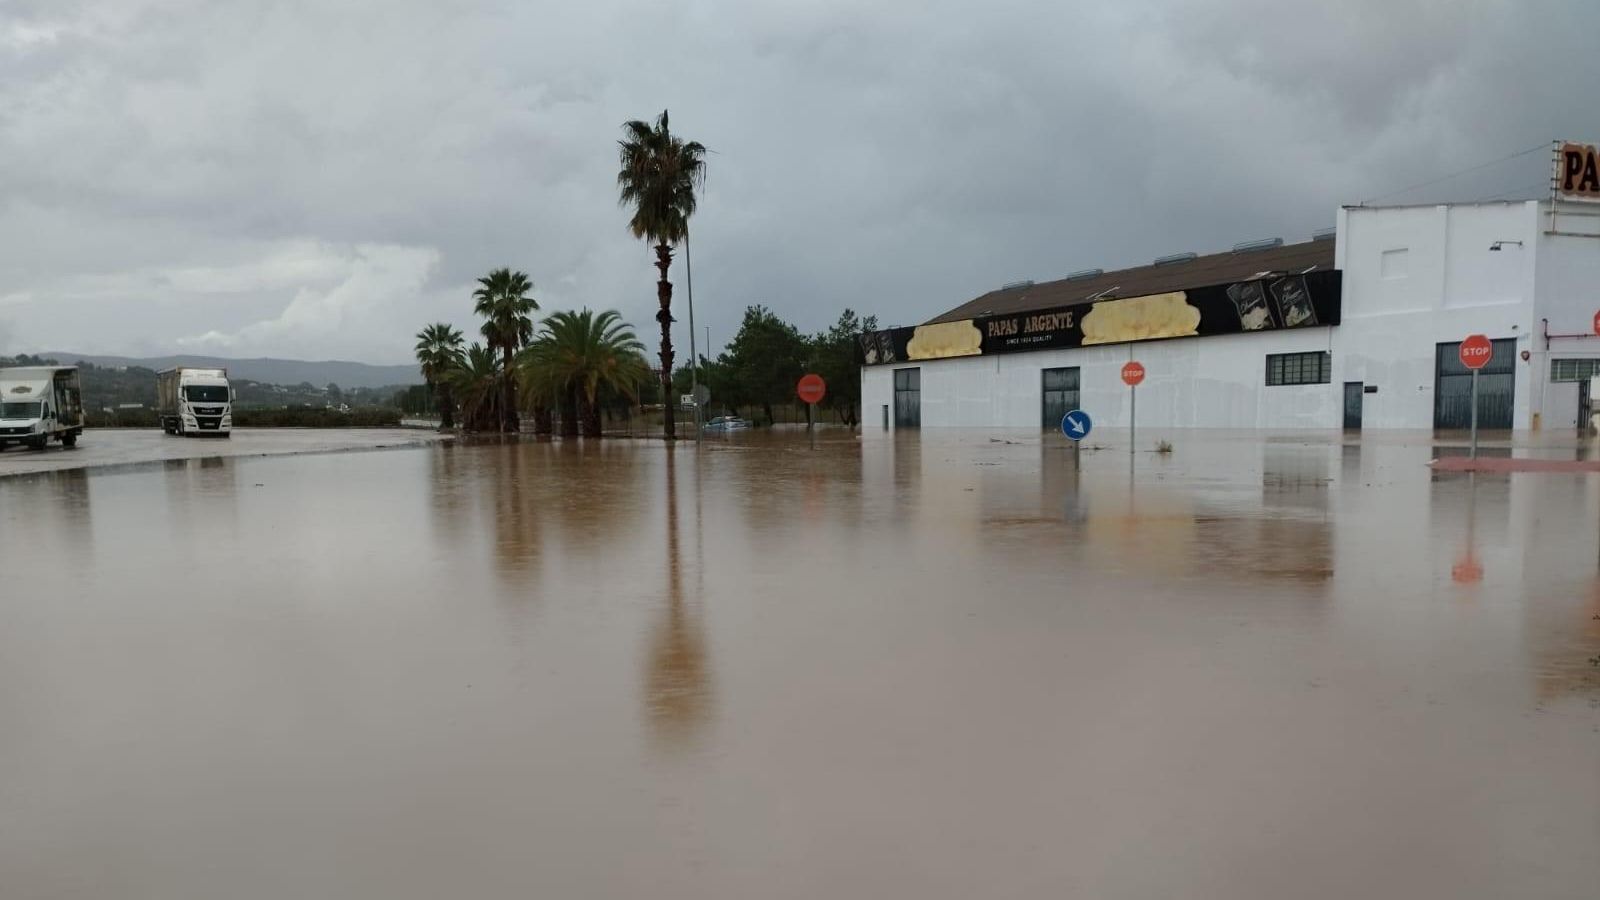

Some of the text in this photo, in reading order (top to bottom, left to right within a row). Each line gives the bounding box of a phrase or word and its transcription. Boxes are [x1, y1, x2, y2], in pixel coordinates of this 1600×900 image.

[1563, 149, 1600, 193] PA
[988, 312, 1073, 337] PAPAS ARGENTE
[1463, 347, 1489, 356] STOP
